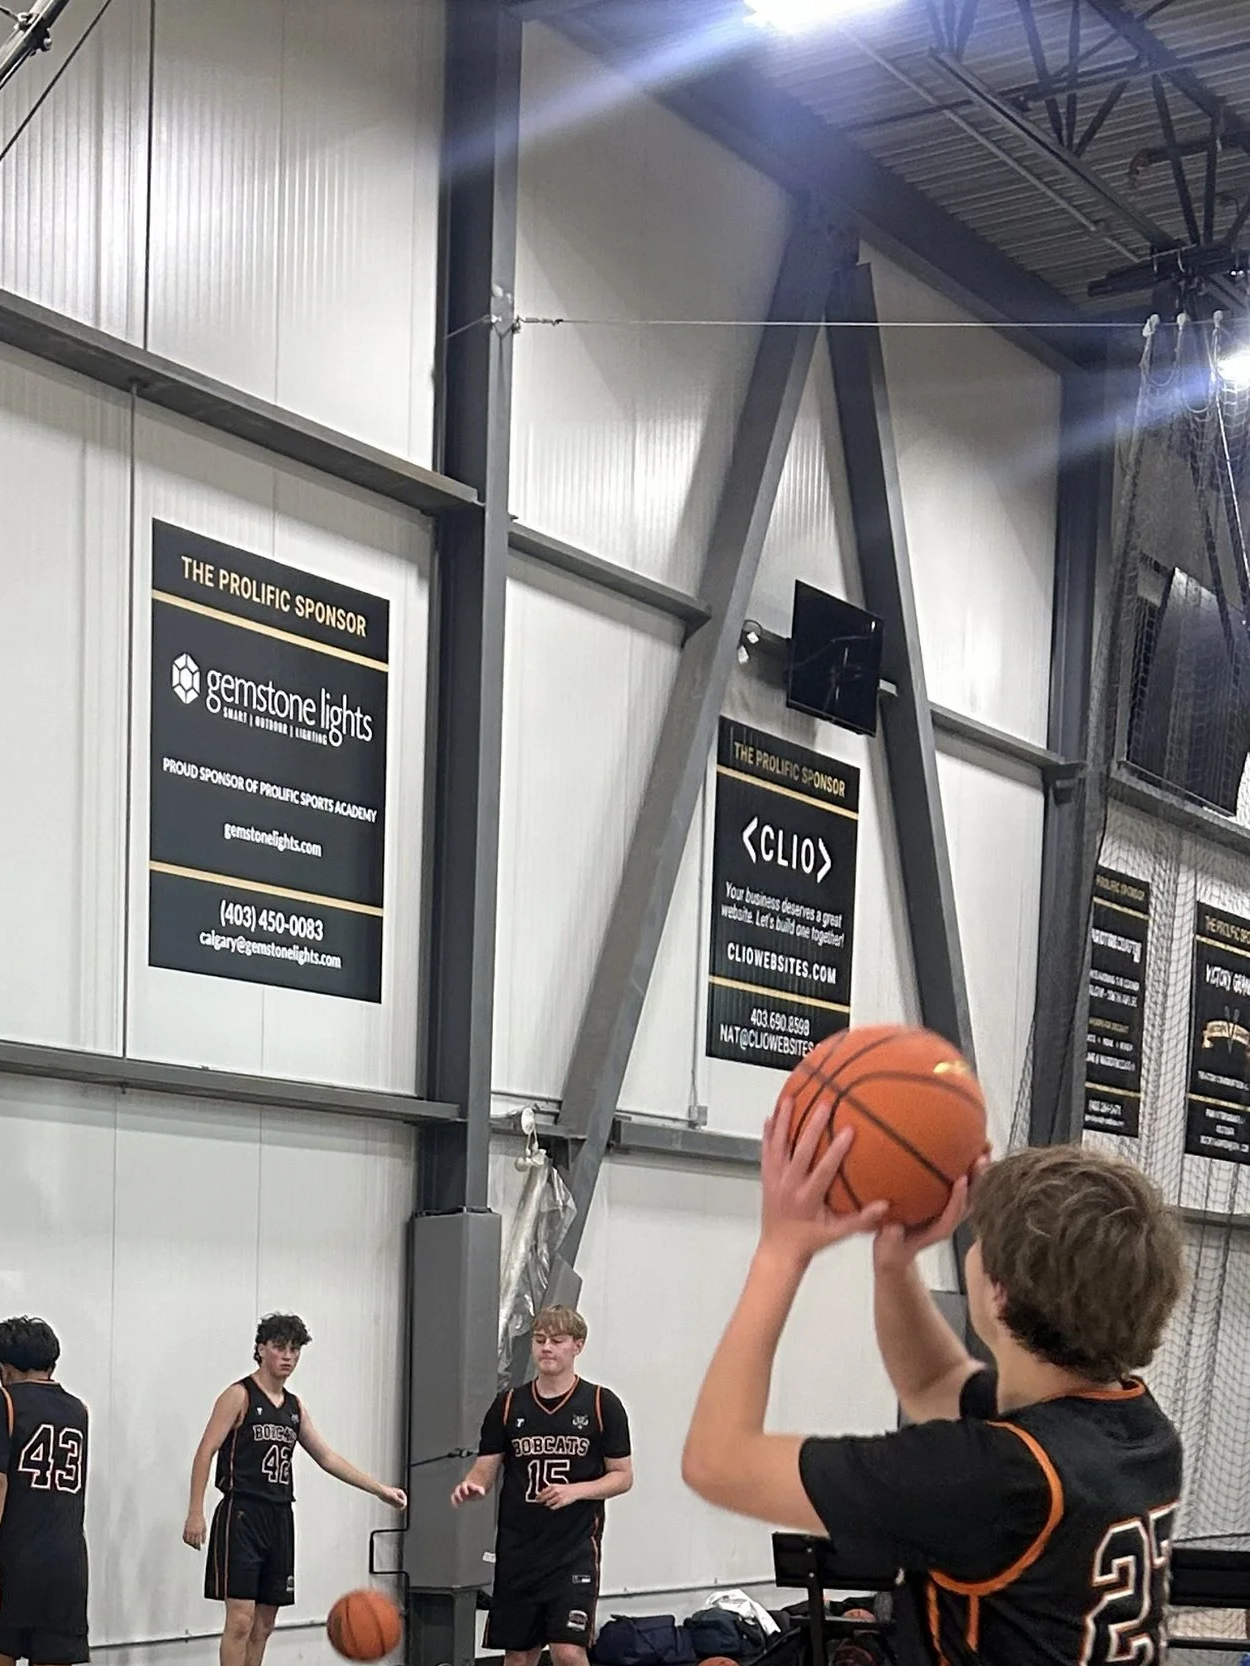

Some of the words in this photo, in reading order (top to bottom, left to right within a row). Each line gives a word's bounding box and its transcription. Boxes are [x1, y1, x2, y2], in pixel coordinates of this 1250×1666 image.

[181, 555, 214, 588] THE
[218, 568, 291, 612] PROLIFIC
[295, 594, 367, 638] SPONSOR
[205, 669, 316, 726] gemstone
[320, 687, 373, 747] lights
[222, 706, 248, 724] SMART
[162, 757, 199, 779] PROUD
[199, 766, 245, 790] SPONSOR
[245, 777, 259, 794] OF
[259, 781, 300, 805] PROLIFIC
[300, 791, 334, 813] SPORTS
[334, 800, 378, 823] ACADEMY
[734, 741, 754, 765] THE
[755, 750, 800, 780] PROLIFIC
[801, 766, 846, 798] SPONSOR
[224, 822, 322, 857] gemstonelights.com
[219, 900, 257, 932] (403)
[258, 909, 324, 941] 450-0083
[725, 881, 745, 900] Your
[745, 886, 781, 911] business
[781, 896, 815, 921] deserves
[815, 910, 822, 923] a
[822, 912, 843, 928] great
[199, 929, 342, 969] calgary@gemstonelights.com
[775, 915, 796, 935] build
[796, 923, 810, 939] one
[727, 942, 837, 985] CLIOWEBSITES.COM
[17, 1423, 84, 1494] 43
[525, 1459, 571, 1503] 15
